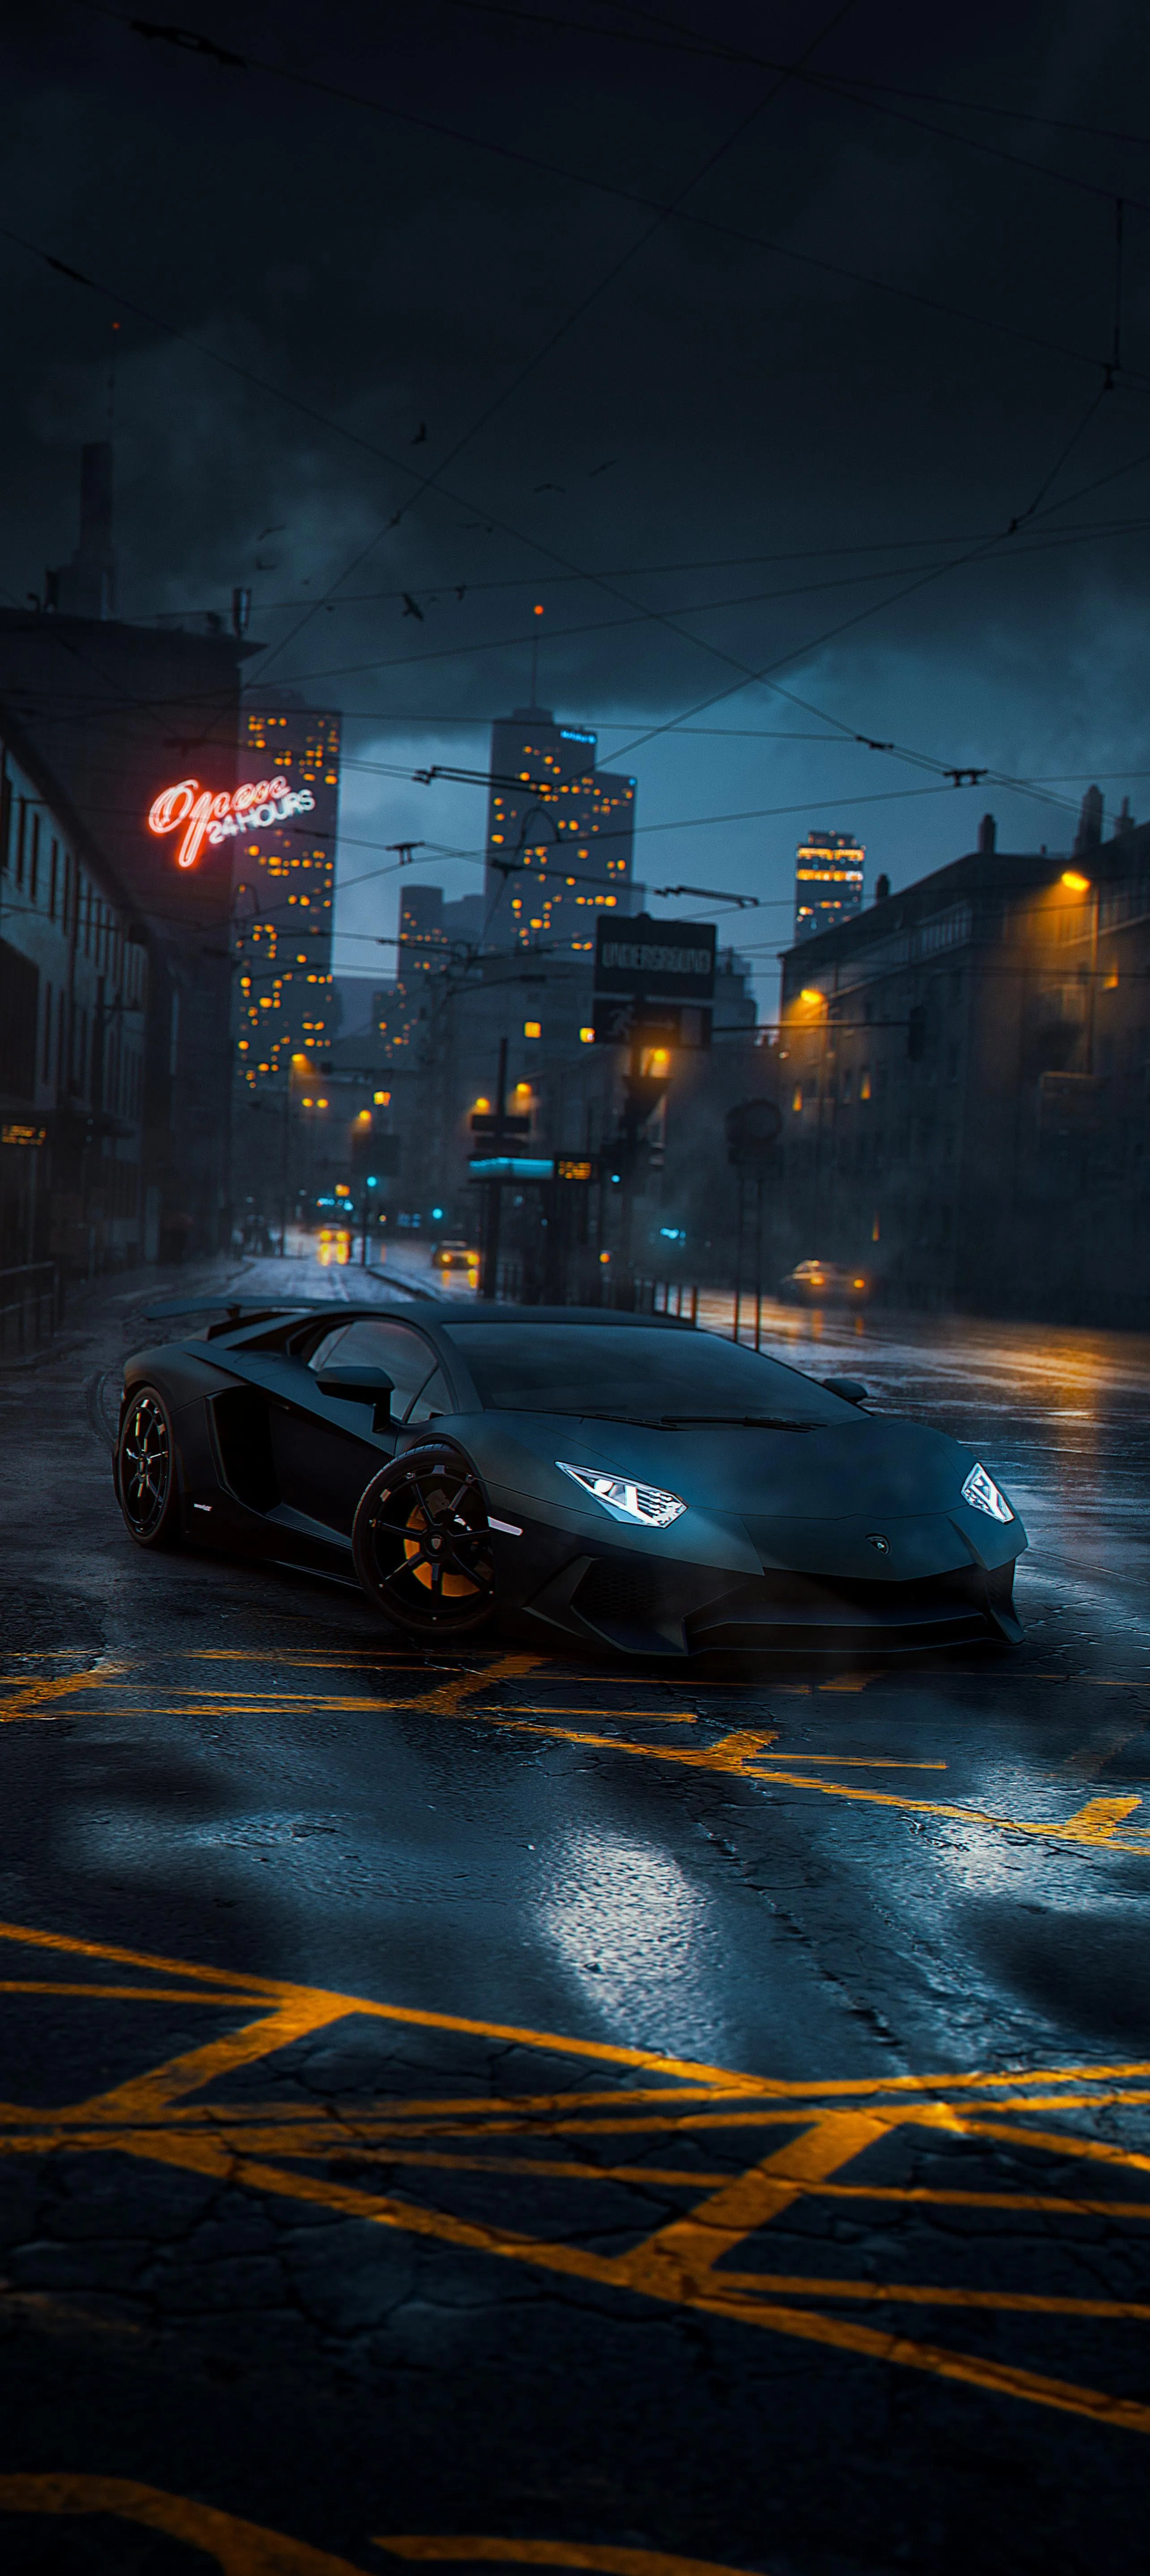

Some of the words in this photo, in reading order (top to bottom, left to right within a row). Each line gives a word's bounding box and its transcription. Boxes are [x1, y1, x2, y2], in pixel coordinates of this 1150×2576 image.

[206, 814, 239, 844] 24
[235, 788, 316, 833] HOURS
[602, 941, 712, 975] UNDERGROUND
